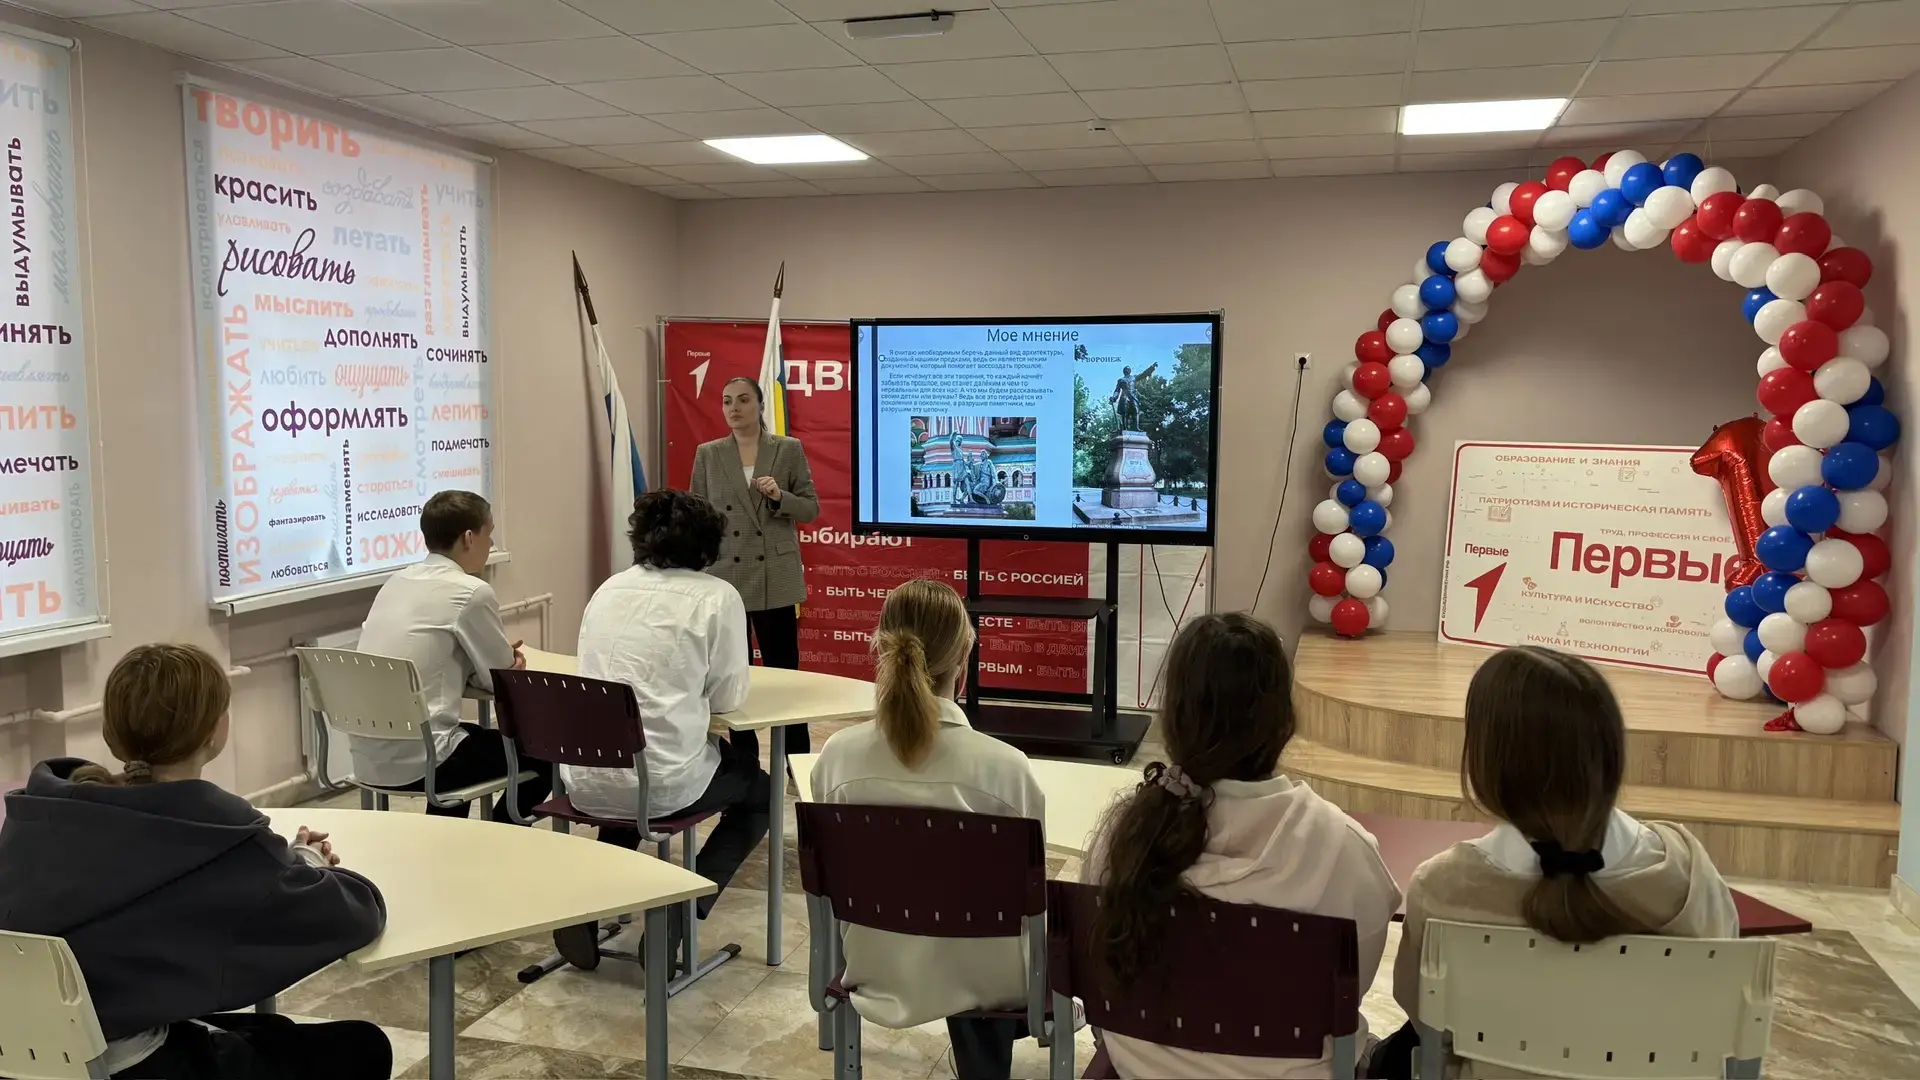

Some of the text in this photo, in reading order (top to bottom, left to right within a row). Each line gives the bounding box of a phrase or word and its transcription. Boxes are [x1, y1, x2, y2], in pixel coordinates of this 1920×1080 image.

[190, 89, 361, 158] творить
[214, 173, 318, 211] красить
[8, 137, 31, 306] выдумывать
[333, 226, 411, 256] летать
[217, 227, 356, 297] рисовать
[459, 224, 469, 338] выдумывать
[255, 294, 354, 318] мыслить
[324, 328, 419, 350] дополнять
[987, 328, 1079, 342] Мое мнение
[426, 347, 488, 364] сочинять
[260, 365, 327, 386] любить
[784, 360, 851, 397] ДВ
[0, 405, 77, 430] пить
[261, 400, 409, 438] оформлять
[431, 404, 489, 421] лепить
[223, 303, 261, 585] ИЗОБРАЖАТЬ
[431, 438, 490, 452] подмечать
[0, 455, 79, 474] мечать
[1495, 454, 1641, 467] ОБРАЗОВАНИЕ И ЗНАНИЯ
[356, 478, 414, 495] стараться
[341, 438, 354, 567] воспламенять
[1479, 496, 1713, 518] ПАТРИОТИЗМ И ИСТОРИЧЕСКАЯ ПАМЯТЬ
[268, 513, 327, 529] фантазировать
[357, 505, 423, 522] исследовать
[215, 499, 231, 588] постигать
[1628, 530, 1691, 541] ПРОФЕССИЯ
[1464, 543, 1509, 557] Первые
[270, 561, 329, 580] любоваться
[997, 571, 1008, 582] С
[1011, 573, 1084, 586] РОССИЕЙ
[0, 581, 62, 620] ть
[826, 586, 866, 598] БЫТЬ
[1521, 590, 1573, 603] КУЛЬТУРА
[1584, 597, 1654, 611] ИСКУССТВО
[833, 630, 873, 642] БЫТЬ
[1653, 626, 1711, 637] ДОБРОВОЛЬ
[1527, 634, 1650, 656] НАУКА И ТЕХНОЛОГИИ
